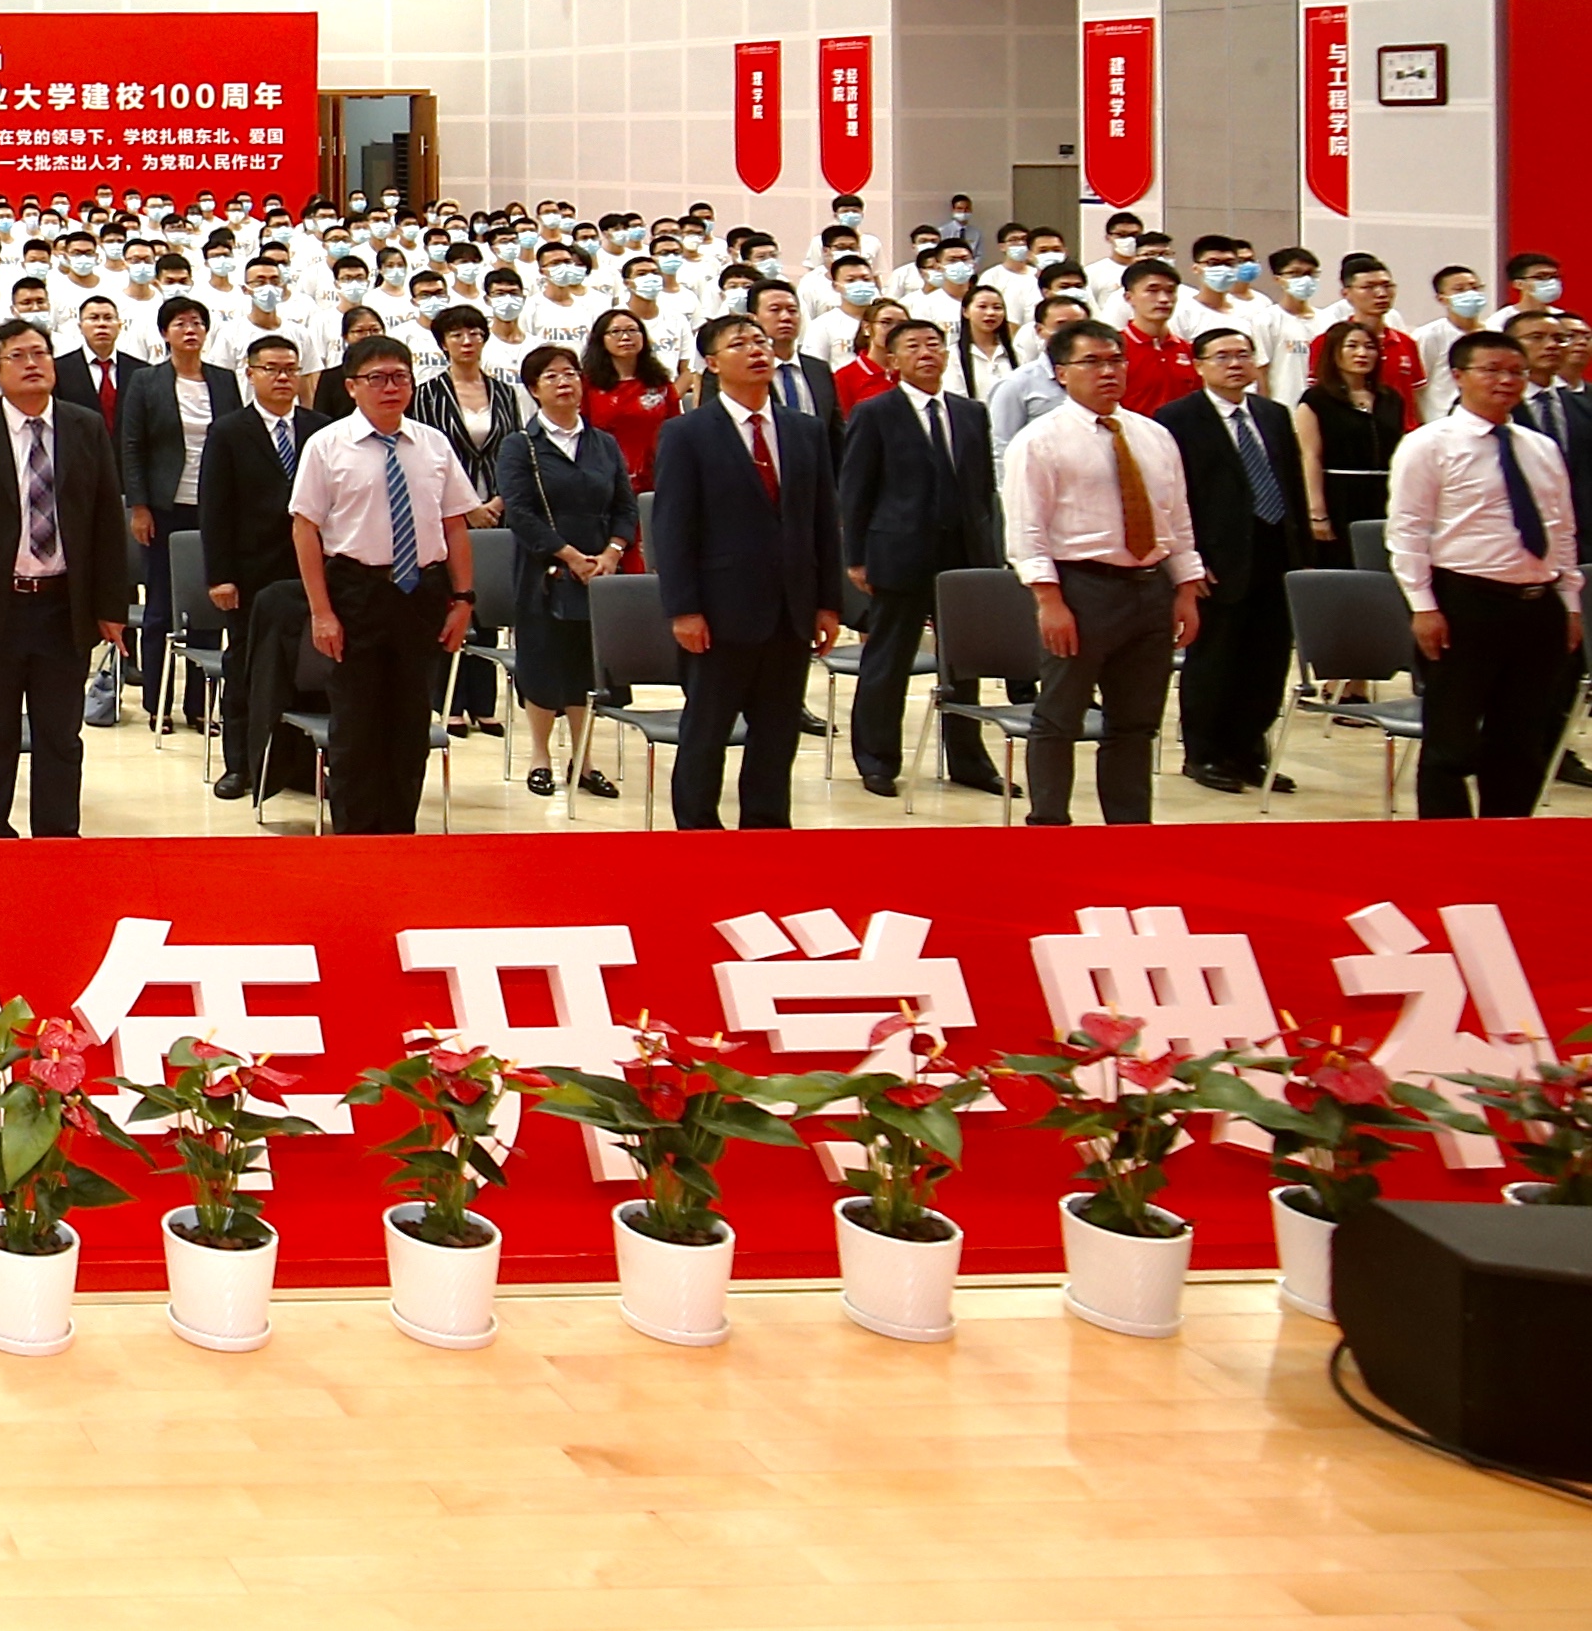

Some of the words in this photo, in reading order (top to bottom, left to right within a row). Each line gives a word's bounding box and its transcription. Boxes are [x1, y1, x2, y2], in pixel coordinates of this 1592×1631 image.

[751, 70, 764, 120] 理学院
[832, 68, 845, 103] 学院
[846, 68, 859, 138] 经济管理
[1108, 56, 1126, 138] 建筑学院
[1327, 42, 1349, 157] 与工程学院
